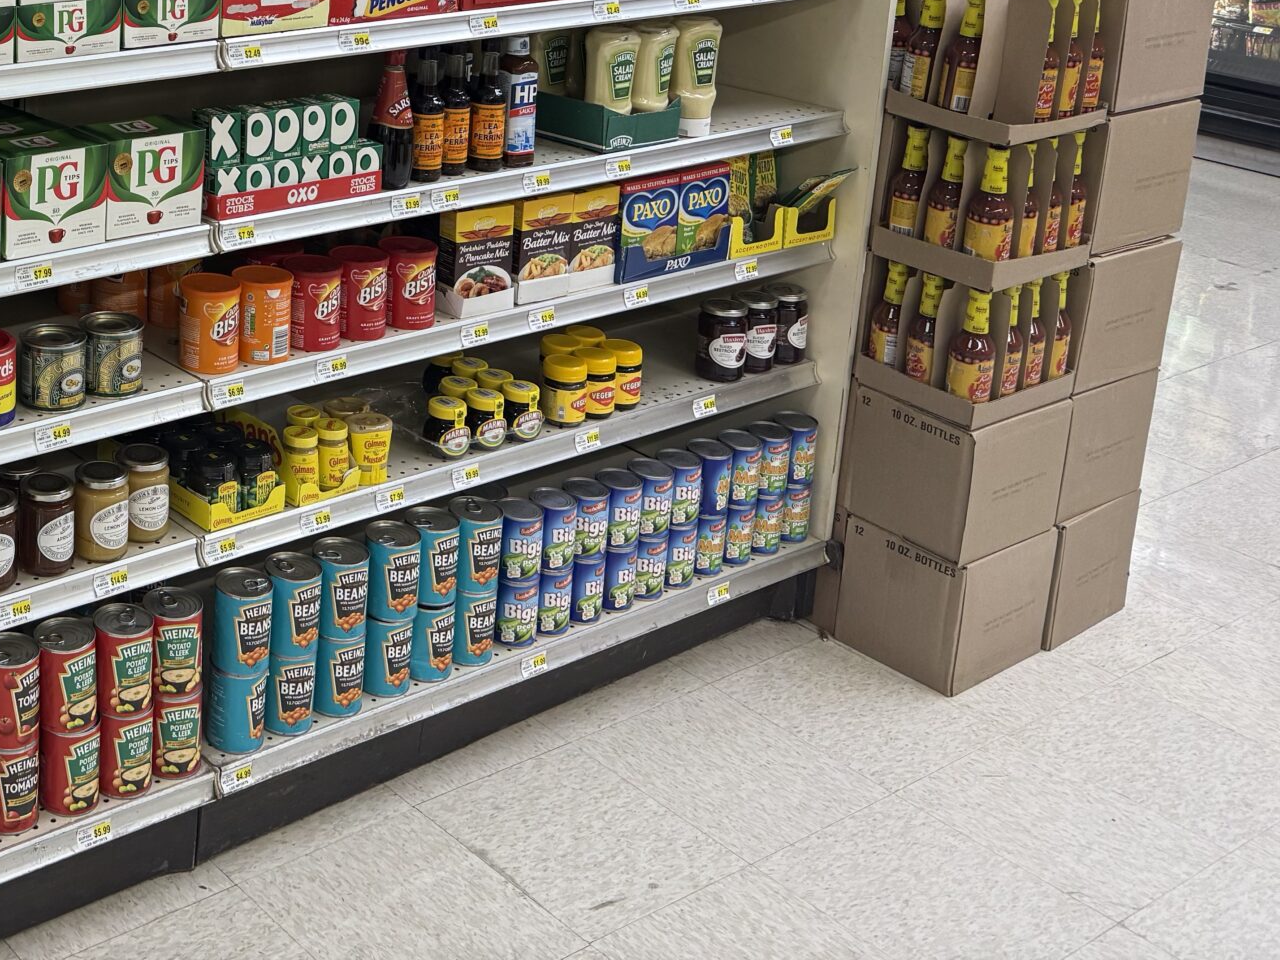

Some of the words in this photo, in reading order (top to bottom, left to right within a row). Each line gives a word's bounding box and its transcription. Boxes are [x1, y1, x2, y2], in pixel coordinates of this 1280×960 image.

[355, 36, 370, 46] 99¢
[695, 51, 716, 63] SALAD
[515, 84, 538, 103] HP
[225, 197, 255, 205] STOCK
[288, 187, 316, 203] OXO
[225, 205, 255, 215] CUBES
[632, 198, 671, 221] PAXO
[523, 234, 550, 249] Batter
[552, 230, 569, 245] Mix
[862, 396, 871, 407] 12
[891, 408, 903, 419] 10
[905, 412, 920, 429] OZ.
[920, 420, 961, 446] BOTTLES
[243, 604, 271, 618] HEINZ
[239, 620, 273, 638] BEANS
